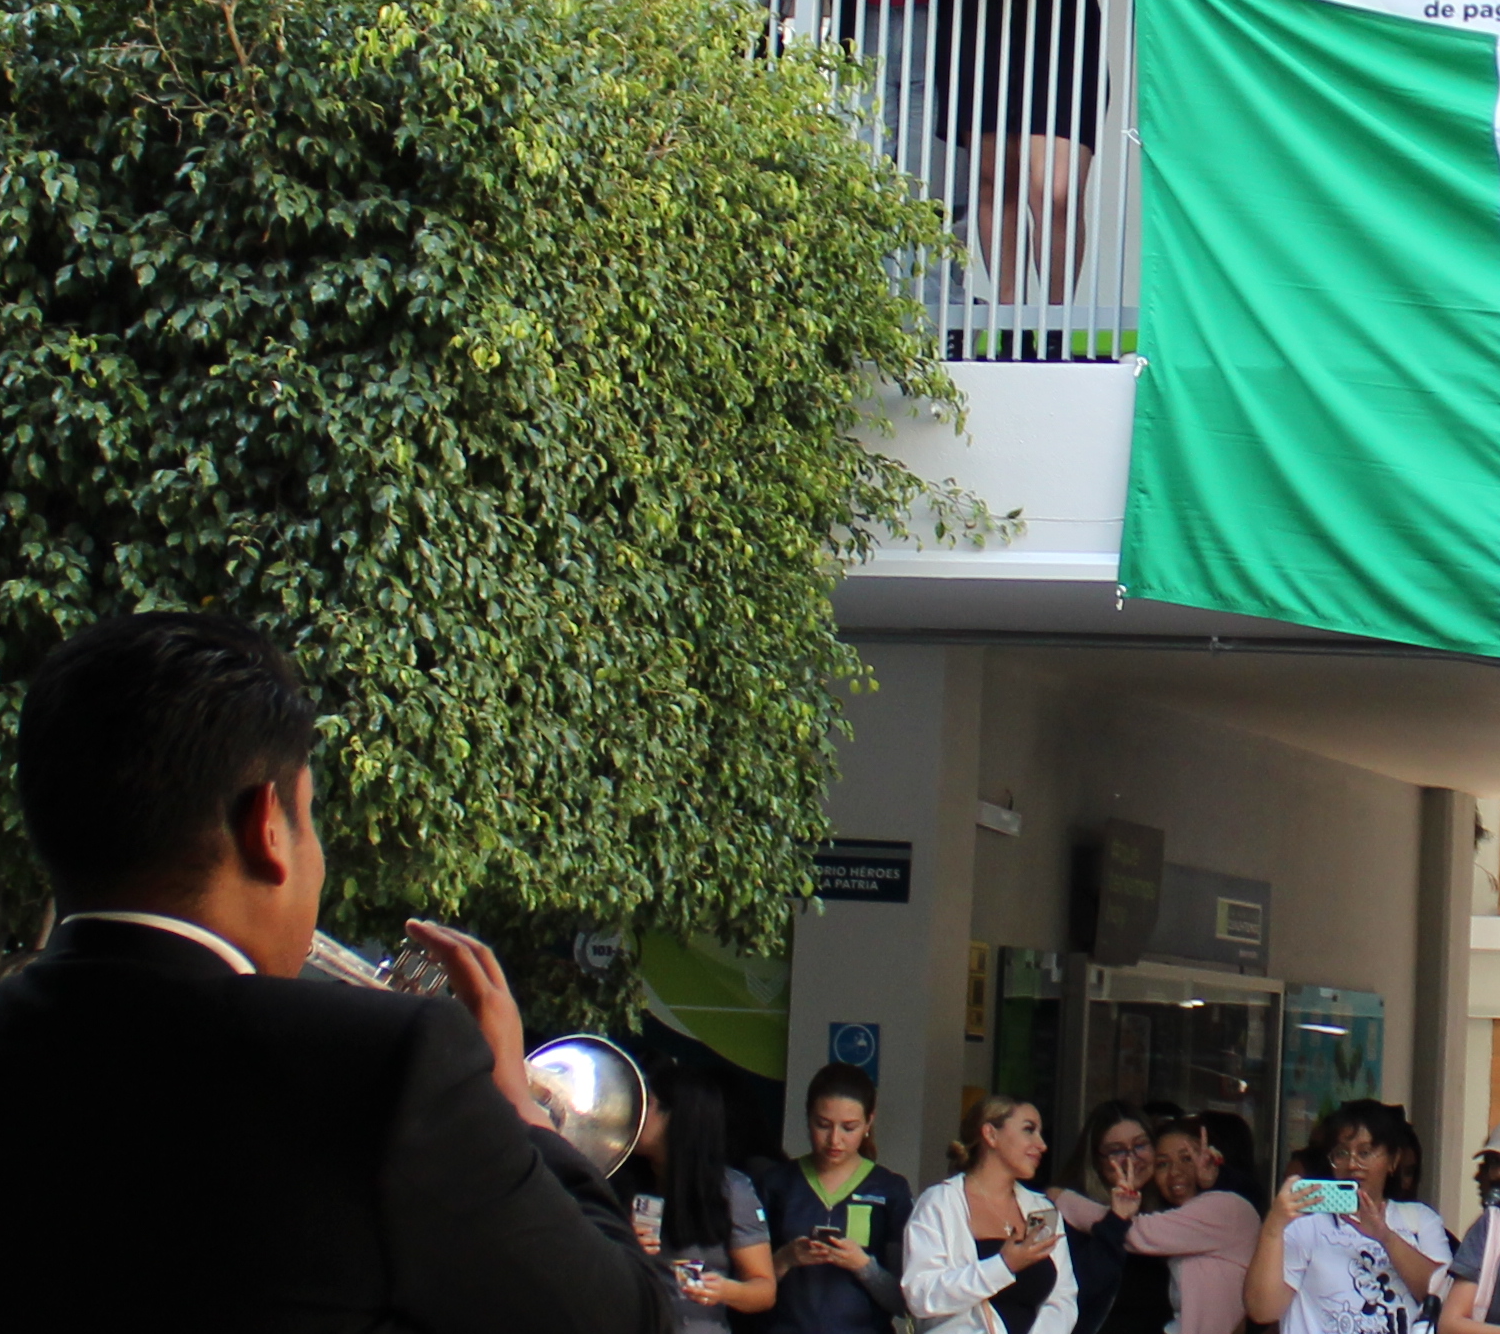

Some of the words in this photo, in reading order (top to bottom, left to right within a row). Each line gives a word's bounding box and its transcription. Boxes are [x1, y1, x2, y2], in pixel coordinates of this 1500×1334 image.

[1423, 0, 1455, 19] de
[850, 866, 901, 880] HÉROES
[834, 878, 879, 891] PATRIA
